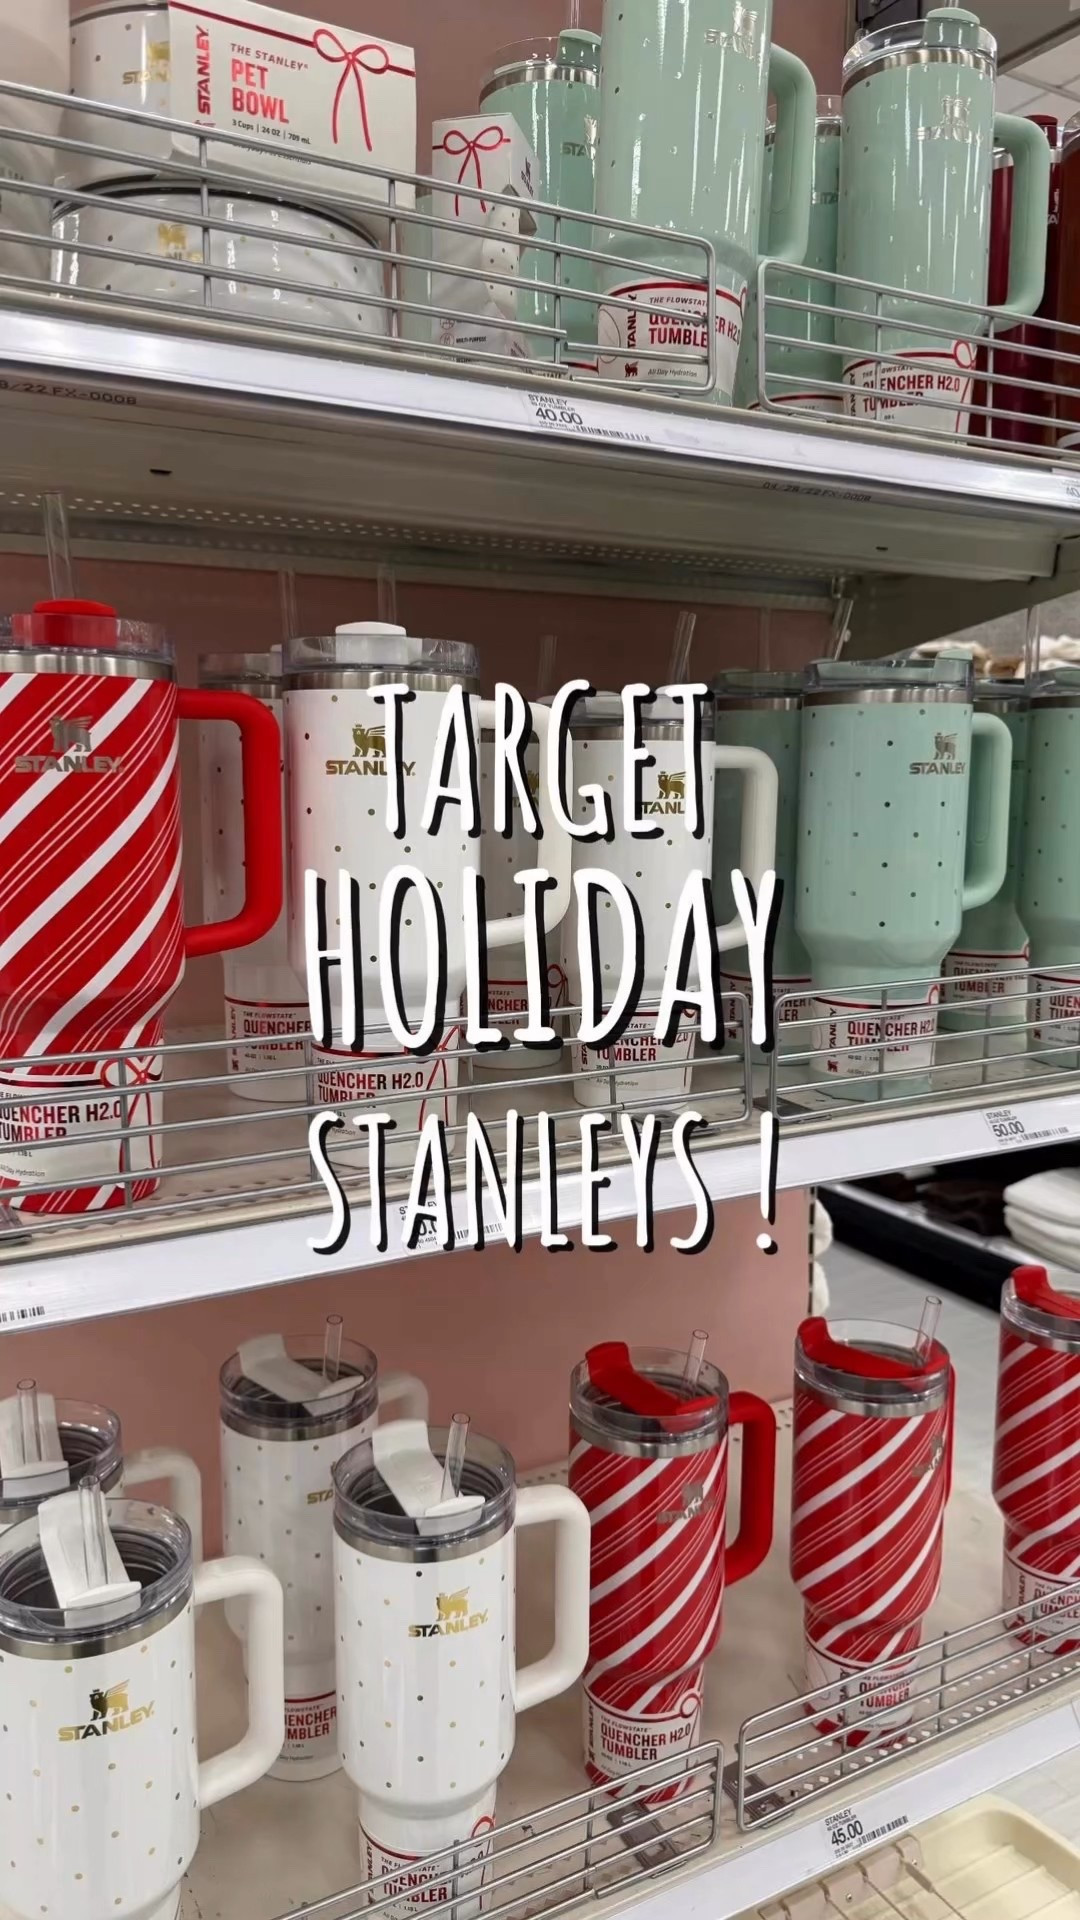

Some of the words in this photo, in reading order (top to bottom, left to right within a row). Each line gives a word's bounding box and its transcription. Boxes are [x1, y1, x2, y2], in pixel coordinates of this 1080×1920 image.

[230, 43, 252, 57] THE
[255, 50, 304, 71] STANLEY
[196, 25, 210, 115] STANLEY
[231, 58, 269, 90] PET
[232, 87, 290, 124] BOWL
[232, 118, 238, 126] 3
[238, 120, 254, 131] Cups
[261, 126, 271, 136] 24
[288, 132, 300, 142] 709
[666, 297, 709, 306] FLOWSTAT
[648, 328, 708, 348] TUMBLE
[528, 394, 568, 407] STANLEY
[535, 407, 583, 426] 40.00
[15, 755, 123, 773] STANLEY
[325, 760, 416, 776] STANLY
[909, 762, 966, 775] STANLEY
[243, 1019, 311, 1035] QUENCHER
[392, 1071, 424, 1089] H2.0
[86, 1100, 122, 1122] H2.0
[986, 1109, 1011, 1120] STANLEY
[992, 1121, 1025, 1137] 50.00
[408, 1609, 488, 1638] STANLEY
[58, 1700, 155, 1741] STANLEY
[611, 1721, 648, 1733] FLOWSTATE
[601, 1722, 667, 1747] QUENCHER
[669, 1723, 692, 1744] H2.0
[600, 1735, 658, 1760] TUMBLER
[825, 1808, 852, 1826] STANLEY
[831, 1820, 863, 1846] 45.00
[381, 1856, 393, 1866] THE
